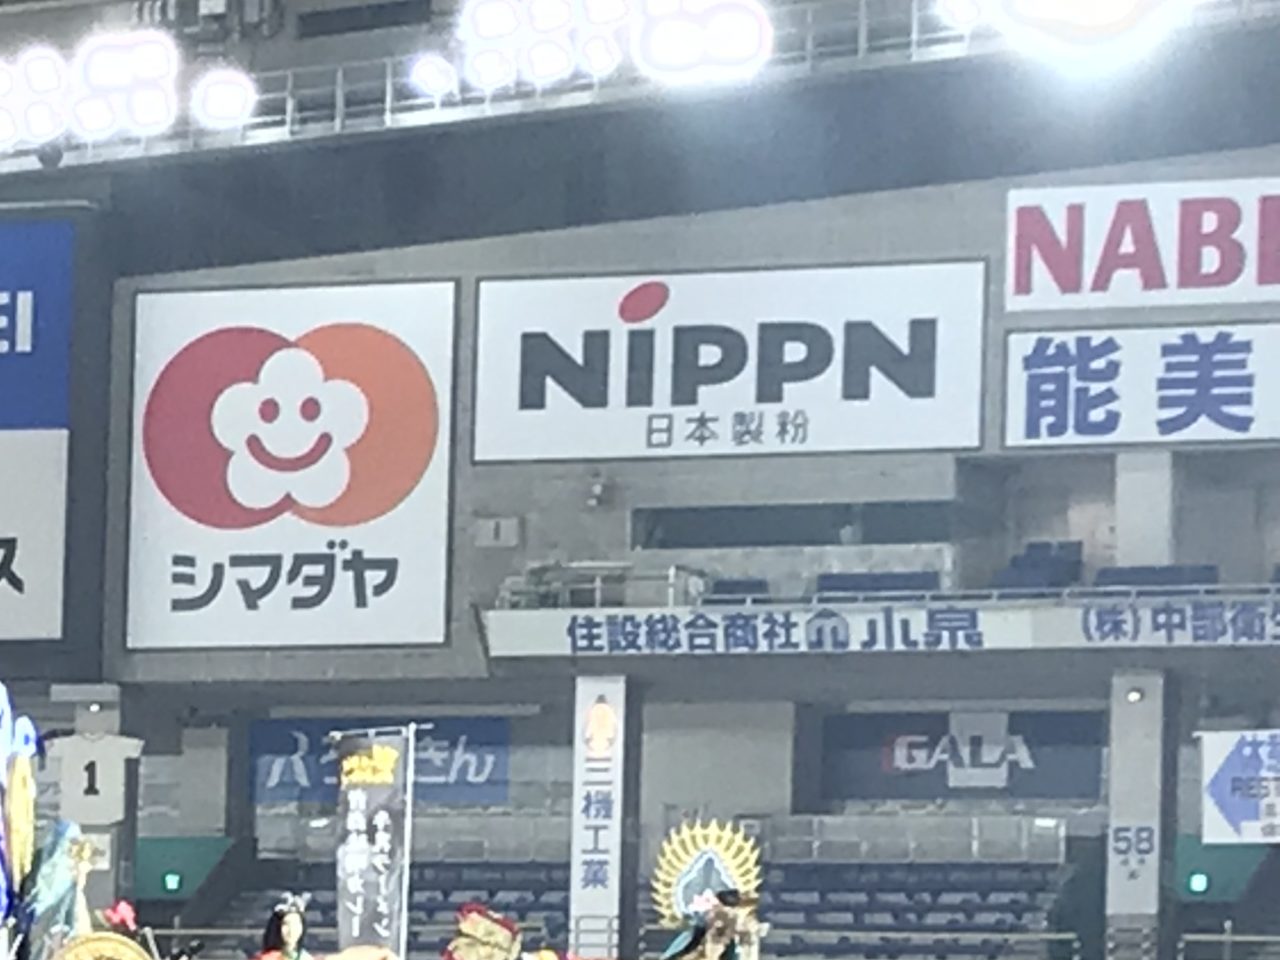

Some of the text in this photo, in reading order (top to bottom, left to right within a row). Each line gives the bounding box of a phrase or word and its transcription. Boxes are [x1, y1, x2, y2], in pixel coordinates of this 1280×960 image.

[1022, 331, 1255, 438] 能美
[646, 411, 811, 449] 日本製粉
[170, 539, 400, 613] シマダヤ
[83, 761, 100, 796] 1
[581, 756, 614, 889] 三機工業
[1114, 826, 1154, 856] 58
